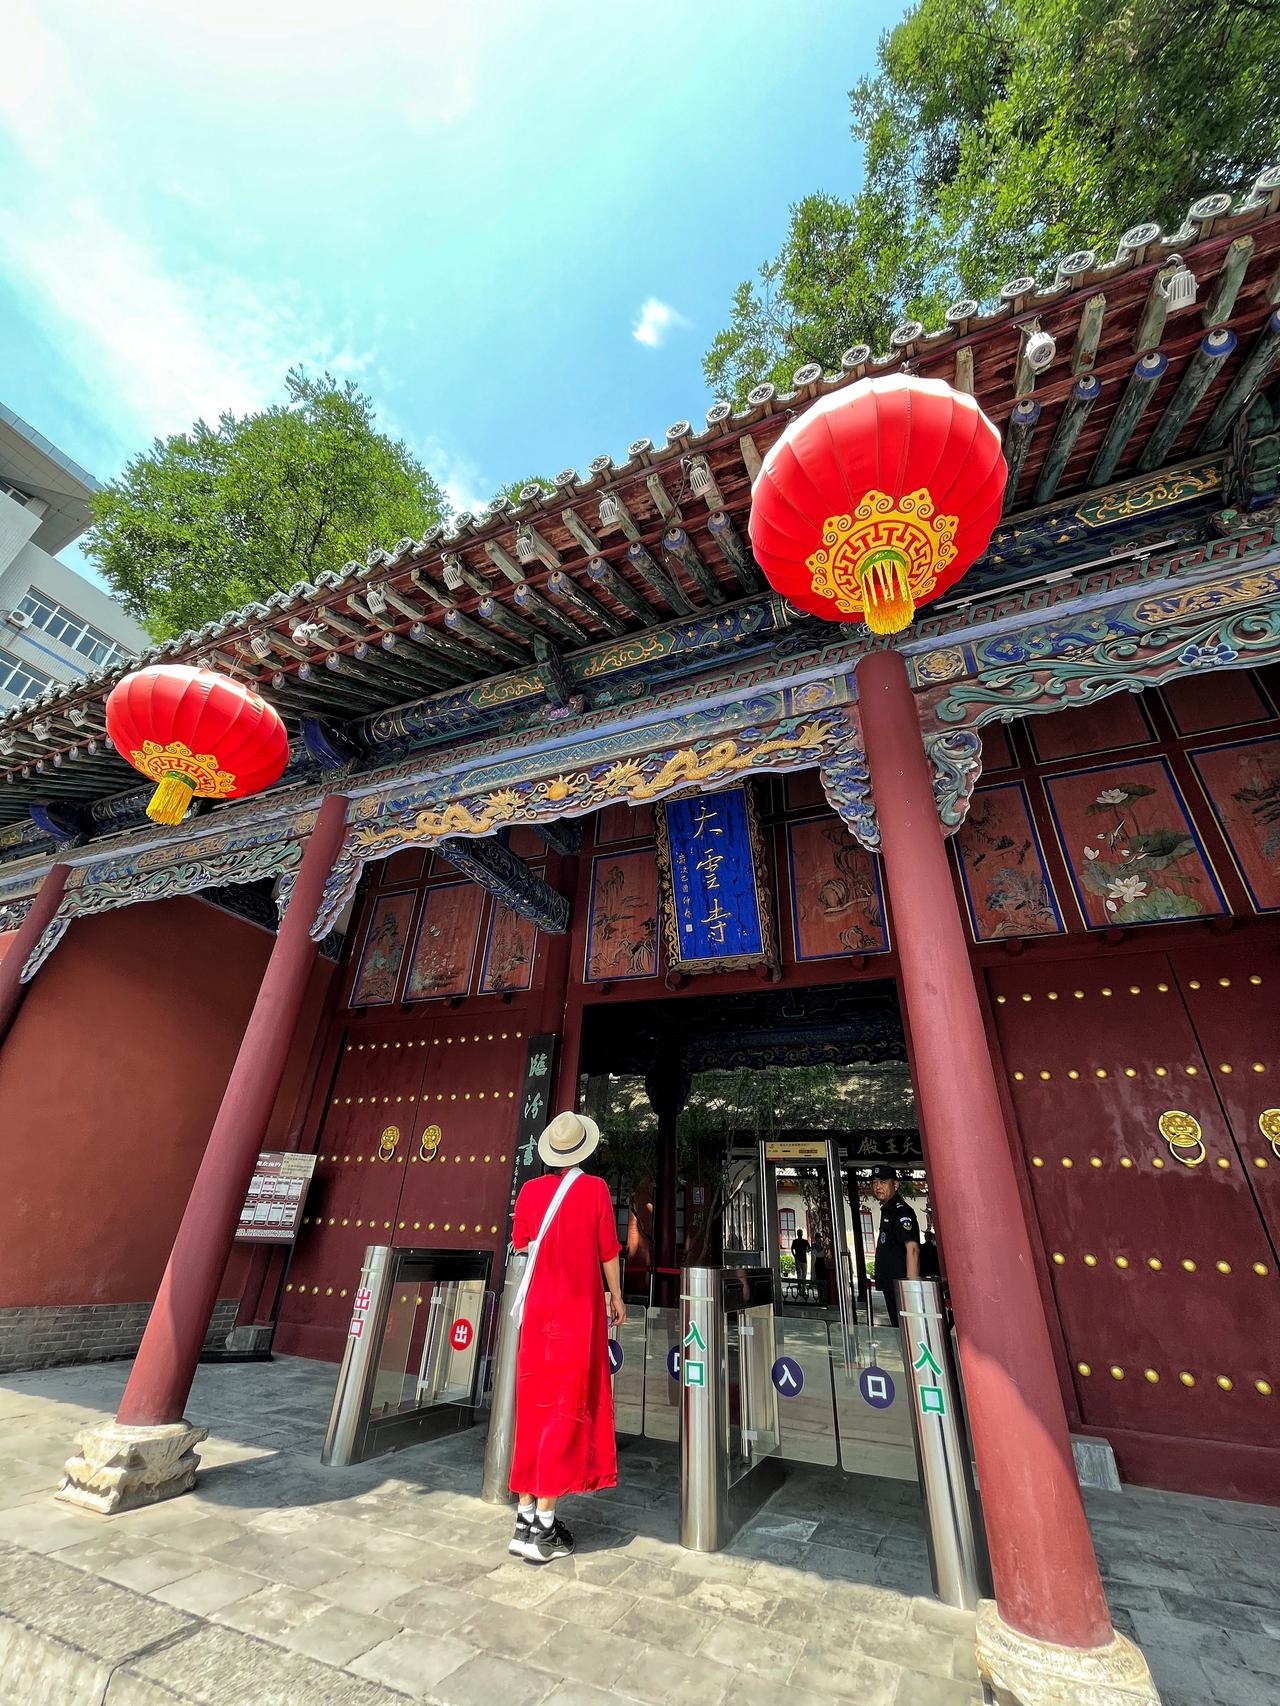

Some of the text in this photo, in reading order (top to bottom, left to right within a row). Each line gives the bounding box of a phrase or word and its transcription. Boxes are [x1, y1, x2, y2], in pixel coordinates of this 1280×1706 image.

[348, 1288, 373, 1340] 出口
[454, 1324, 468, 1344] 出
[683, 1320, 707, 1388] 入口
[913, 1341, 946, 1416] 入口
[778, 1363, 888, 1400] 入 口
